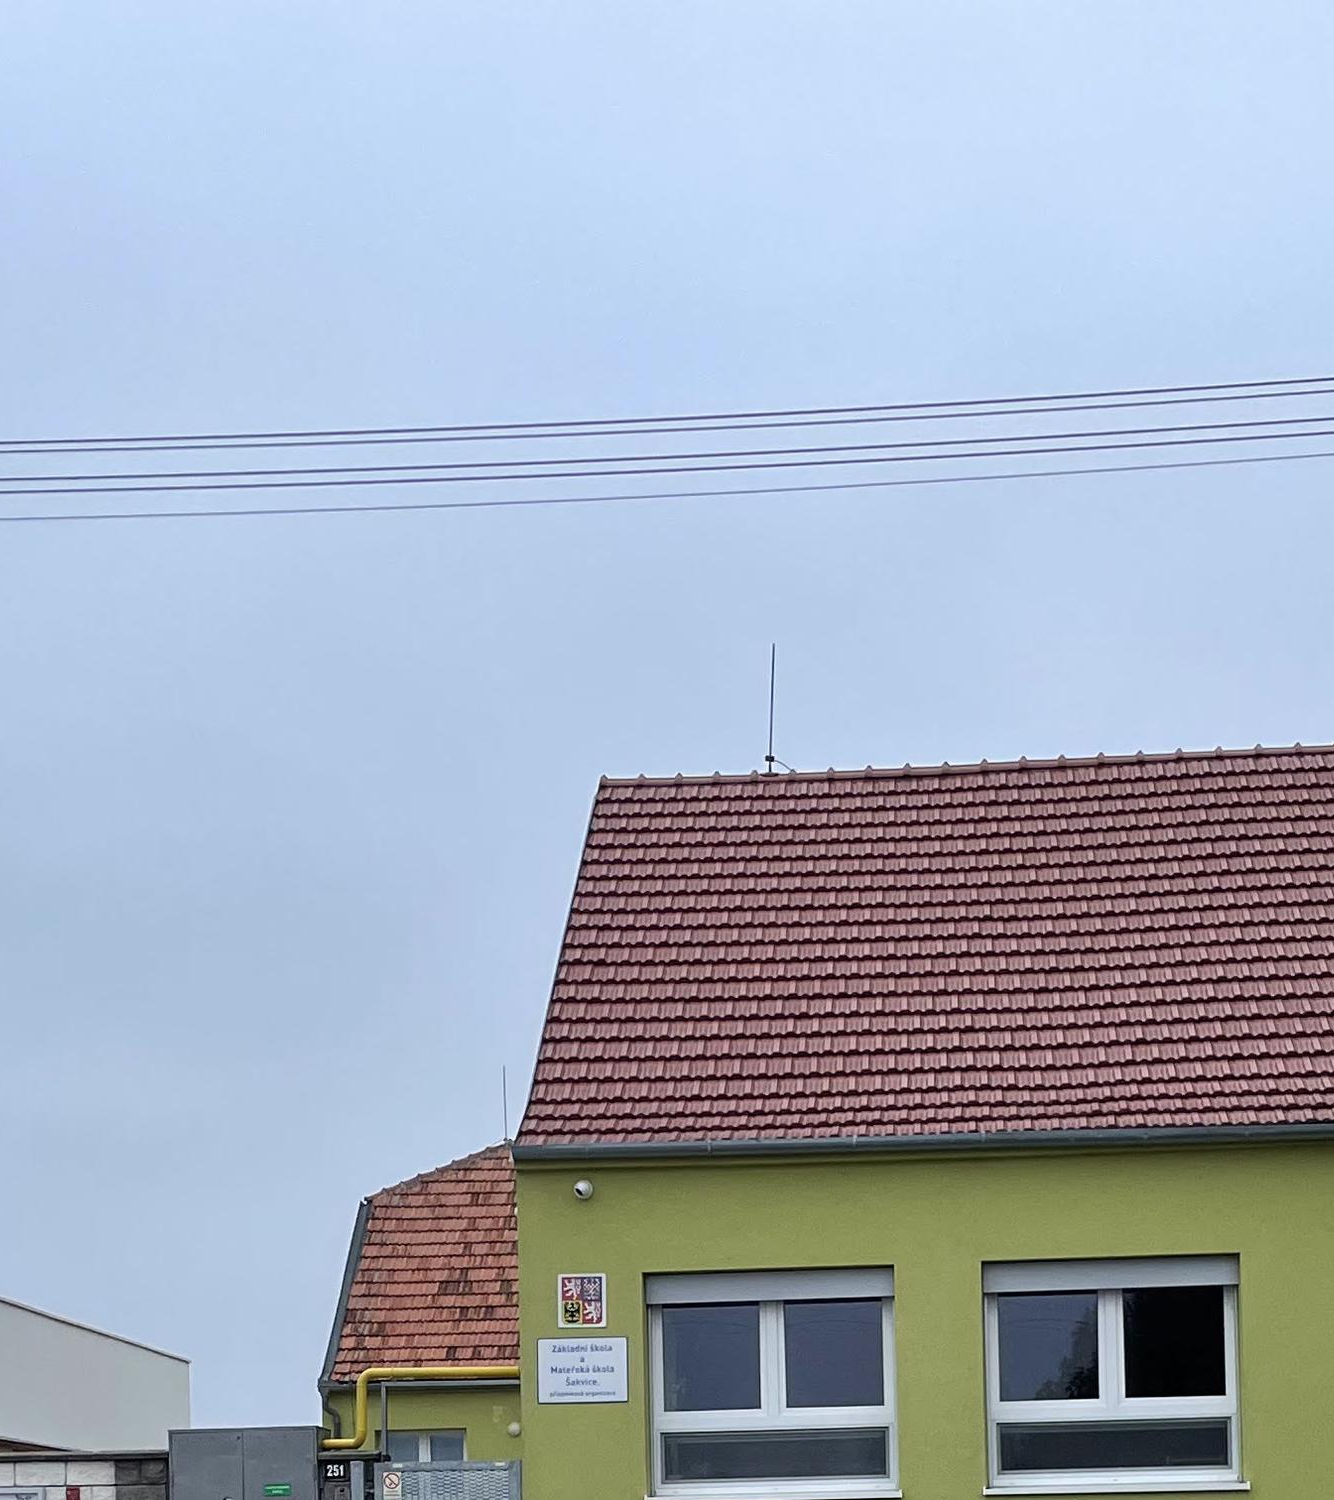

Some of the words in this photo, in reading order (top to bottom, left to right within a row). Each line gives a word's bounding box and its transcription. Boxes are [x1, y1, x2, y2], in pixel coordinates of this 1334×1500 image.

[551, 1344, 588, 1353] Základní
[590, 1343, 613, 1352] škola
[550, 1365, 590, 1374] Mateřská
[592, 1364, 615, 1373] škola
[326, 1464, 344, 1477] 251
